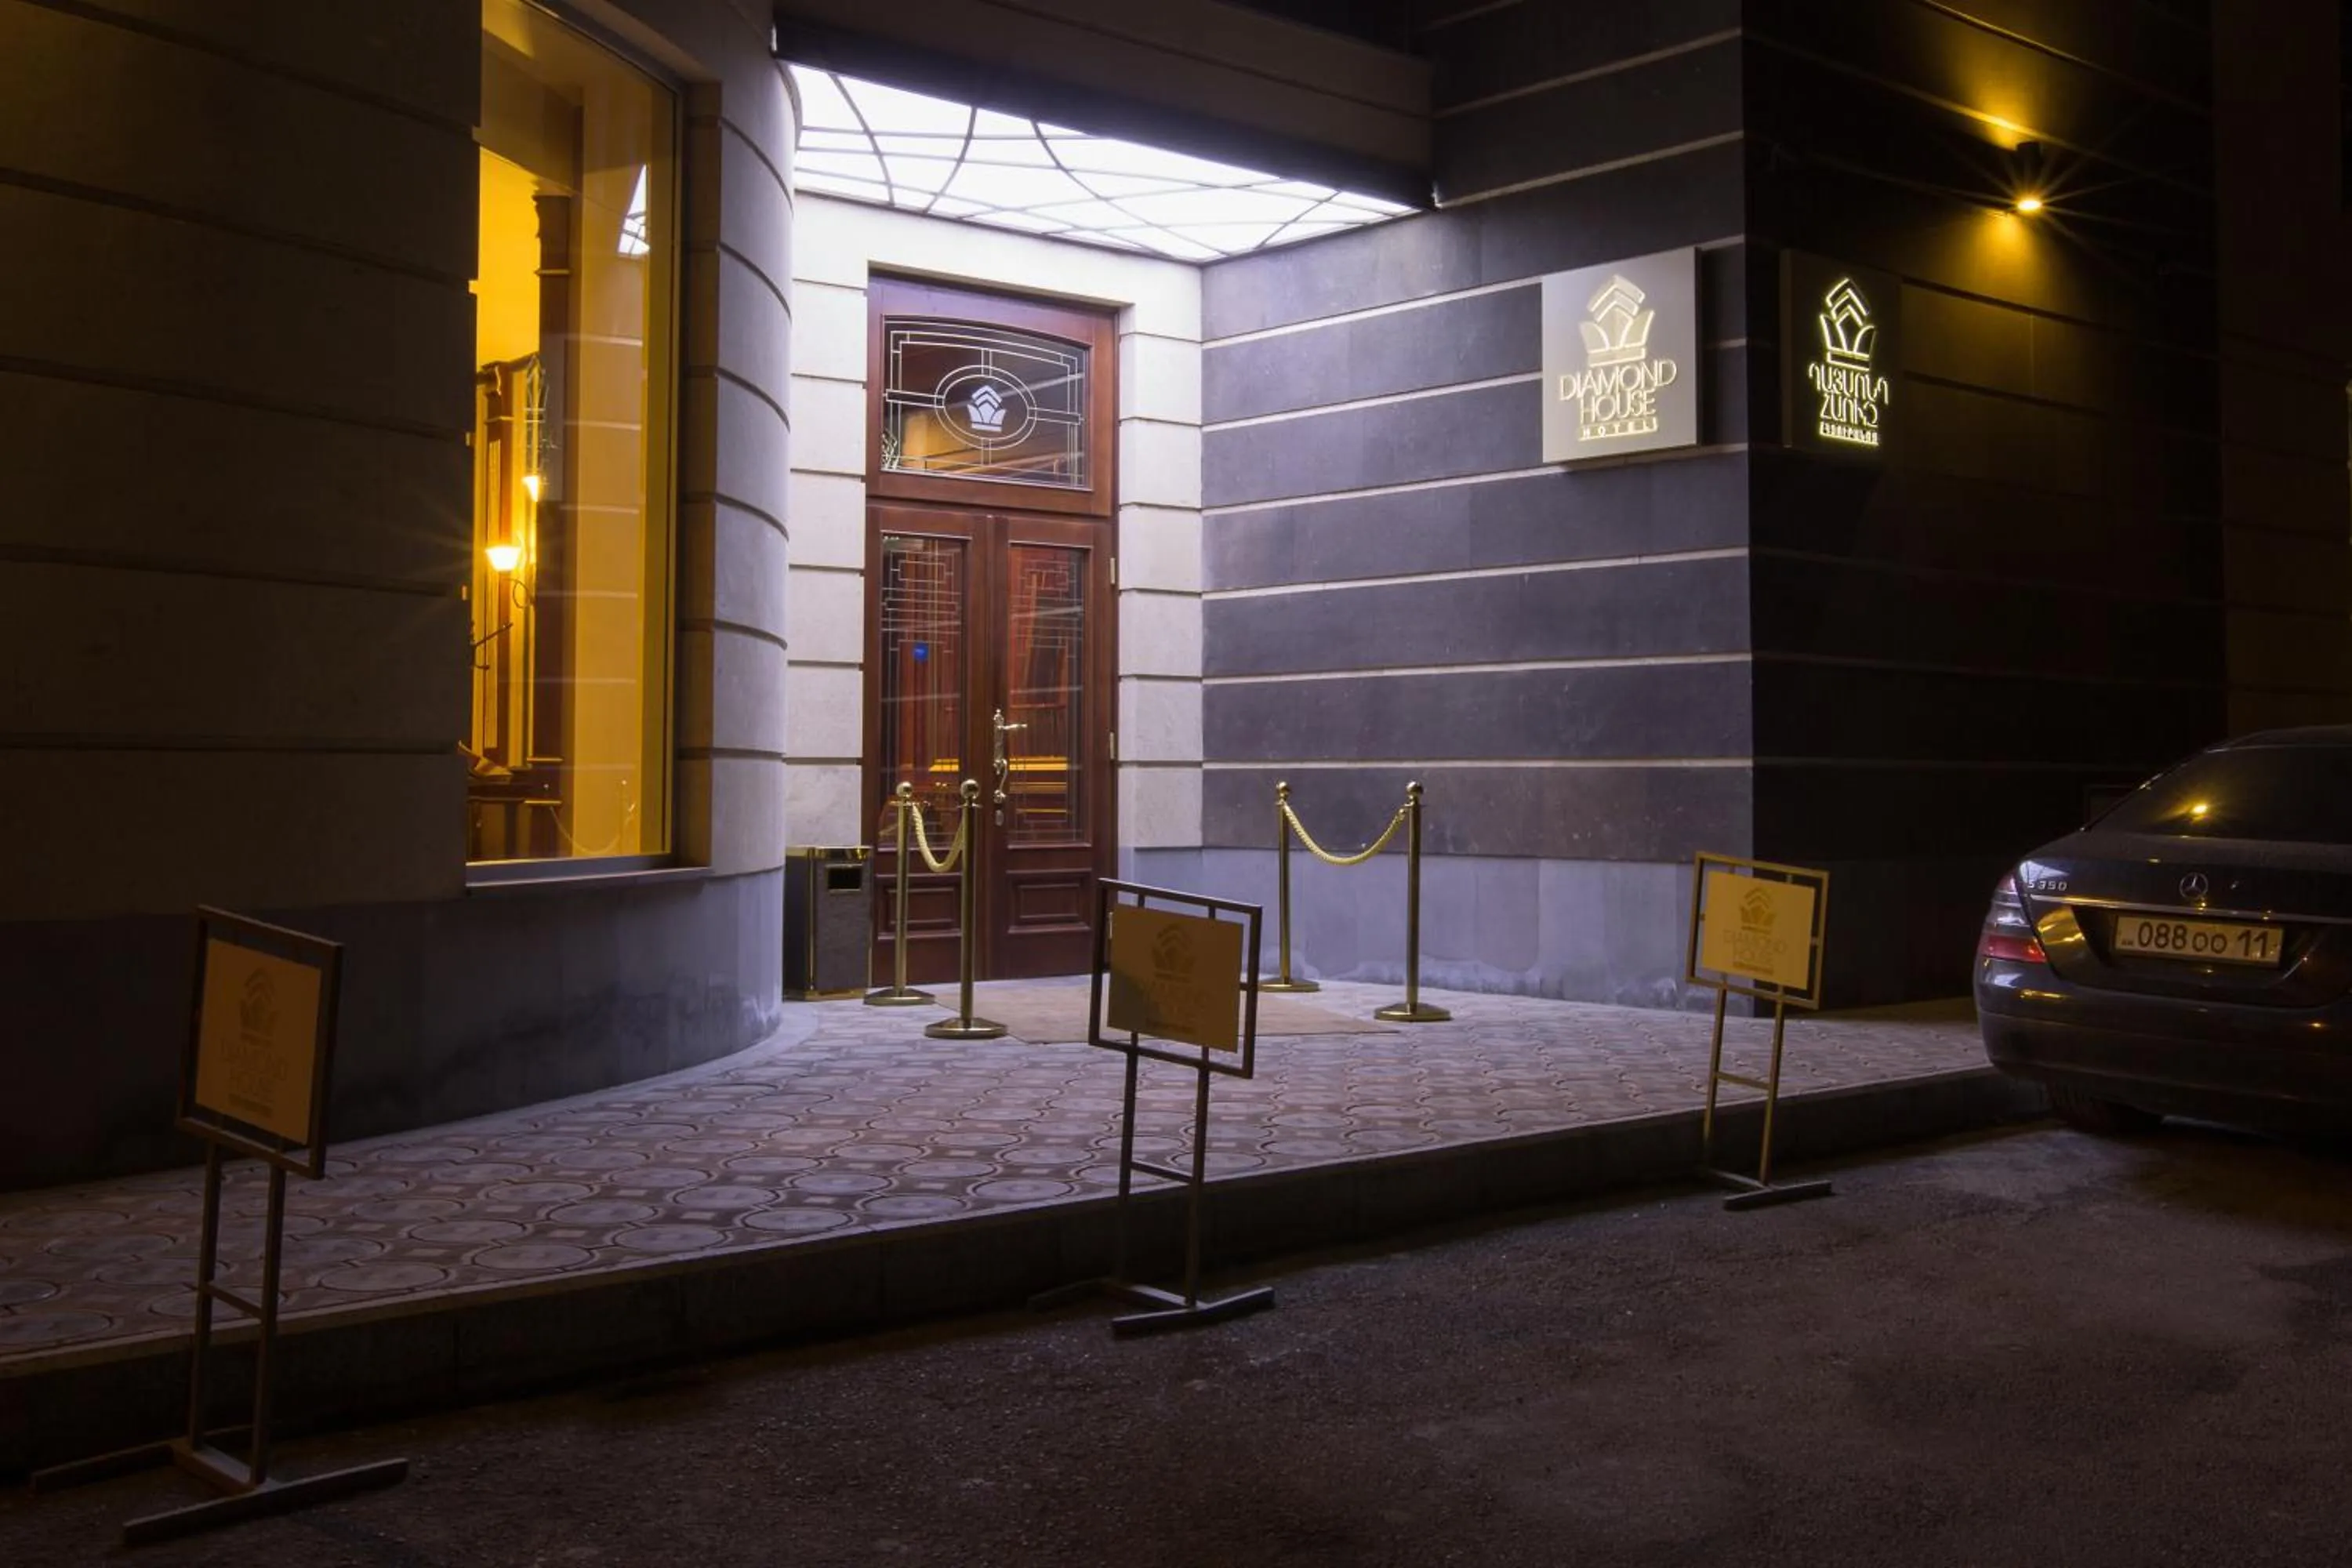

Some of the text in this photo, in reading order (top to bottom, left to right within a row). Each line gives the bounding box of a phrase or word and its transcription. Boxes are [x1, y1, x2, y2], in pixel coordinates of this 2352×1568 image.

[1560, 360, 1676, 401] DIAMOND
[1581, 388, 1657, 423] HOUSE
[2138, 922, 2187, 949] 088
[2238, 930, 2268, 957] 11
